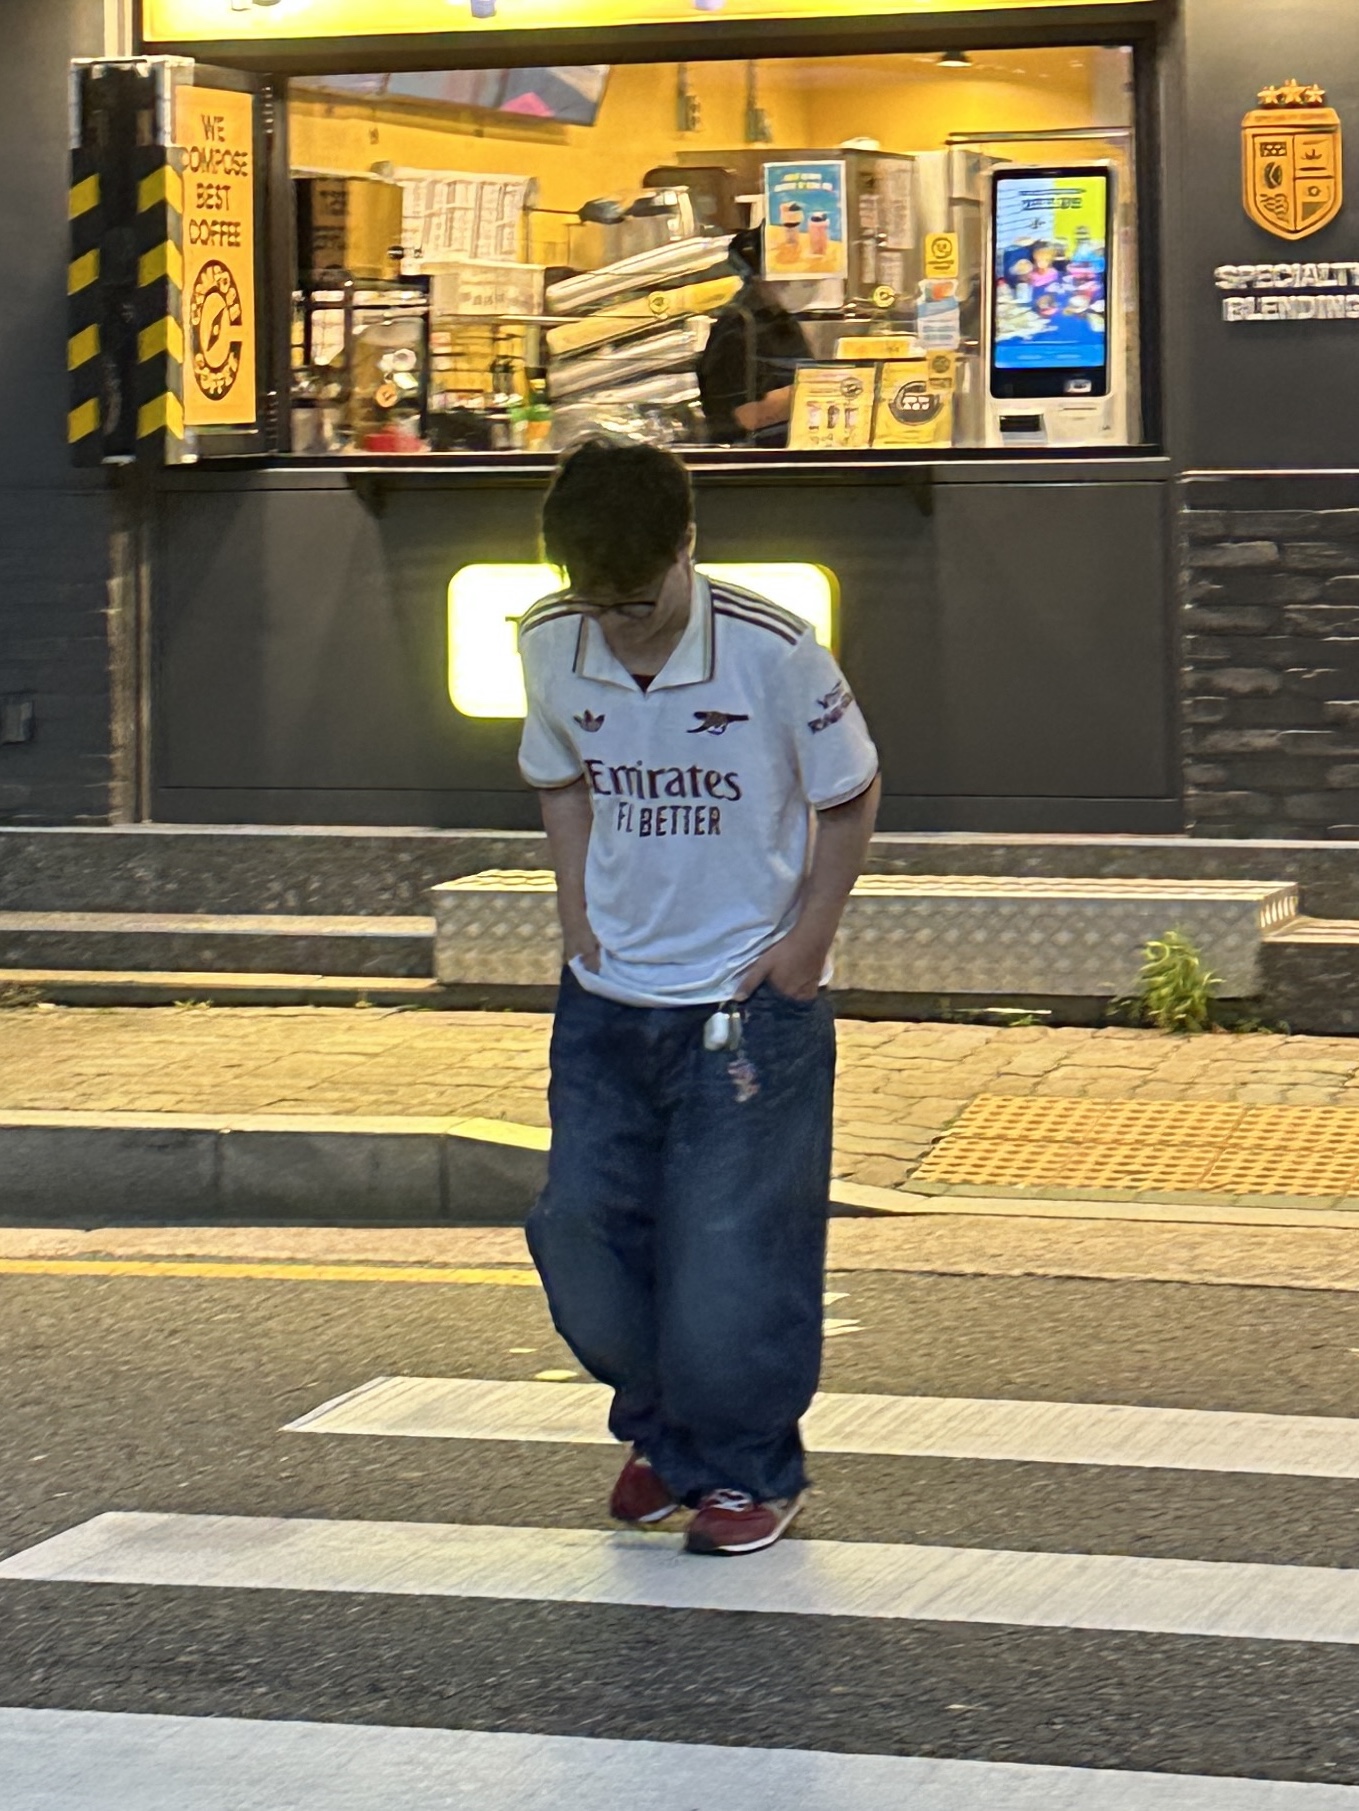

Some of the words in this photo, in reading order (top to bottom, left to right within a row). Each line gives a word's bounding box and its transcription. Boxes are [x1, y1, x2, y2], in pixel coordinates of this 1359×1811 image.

[201, 114, 225, 142] WE
[196, 182, 231, 211] BEST
[189, 219, 241, 247] COFFEE
[584, 759, 742, 802] Emirates
[640, 805, 721, 838] BETTER
